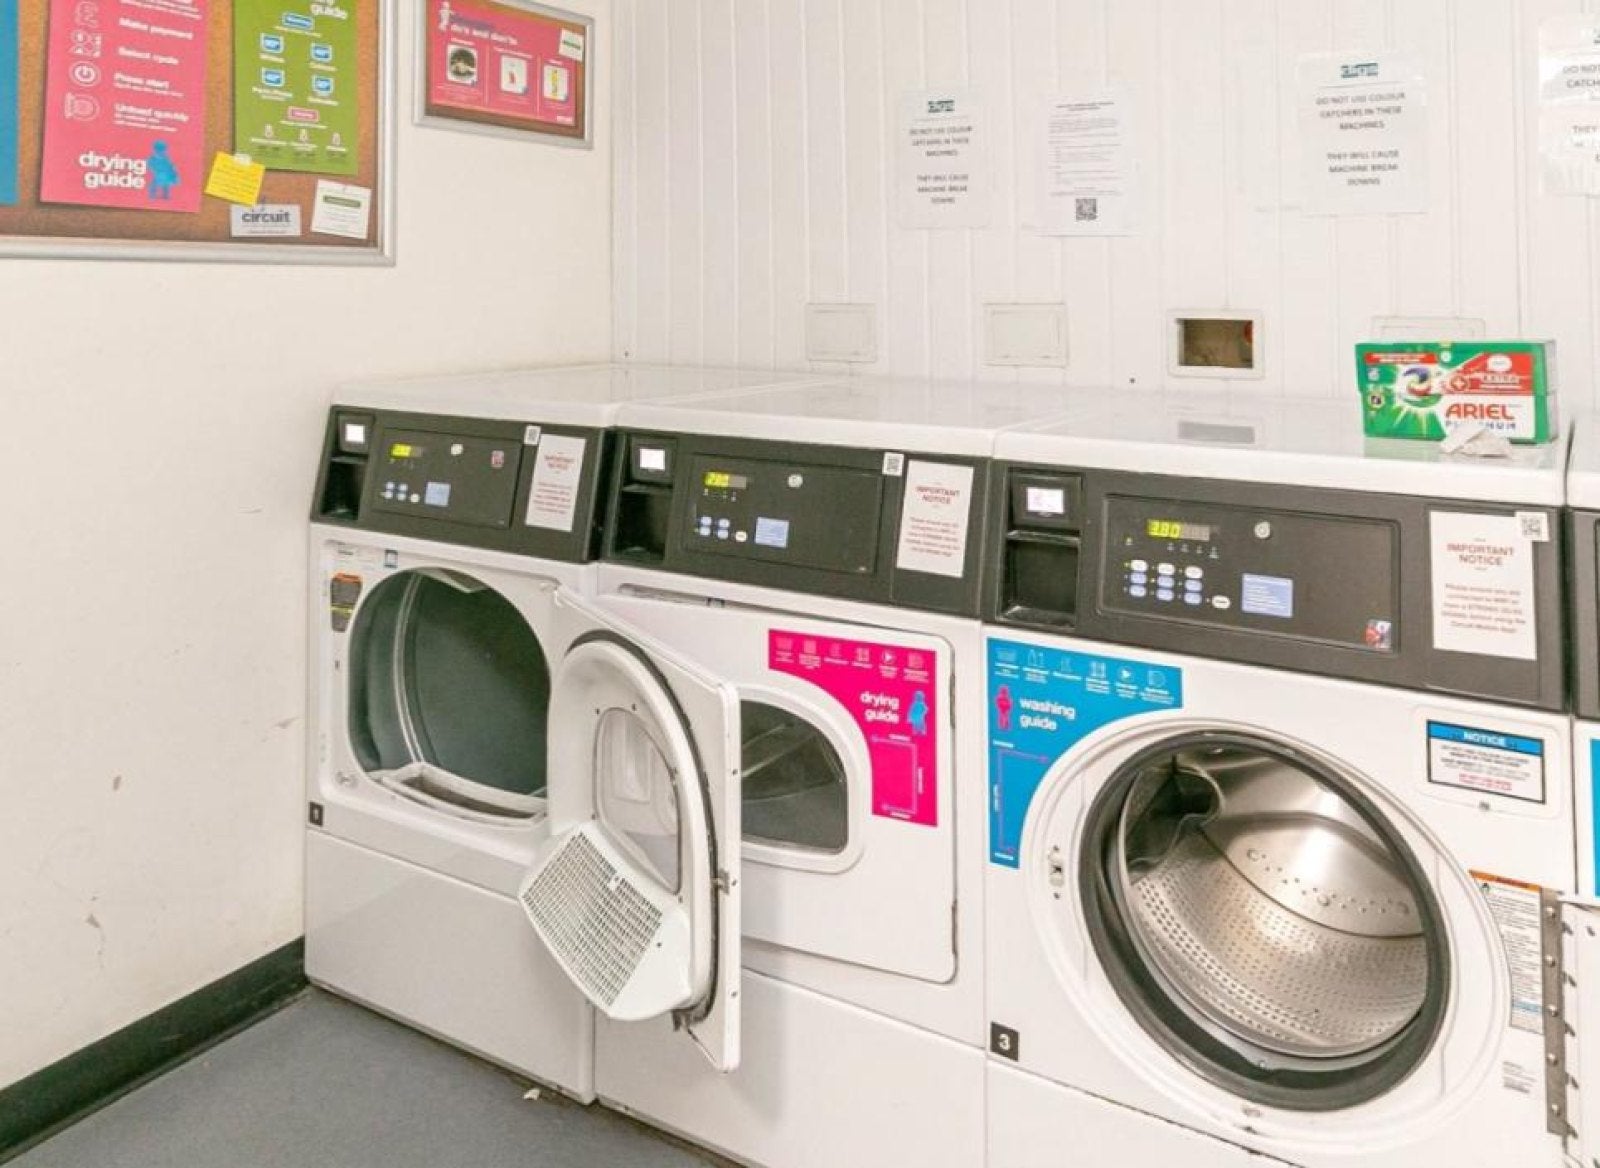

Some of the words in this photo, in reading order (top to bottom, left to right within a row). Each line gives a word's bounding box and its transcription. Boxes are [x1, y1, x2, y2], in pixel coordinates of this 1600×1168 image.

[1368, 92, 1405, 102] COLOUR
[1371, 148, 1399, 158] CAUSE
[79, 151, 147, 175] drying
[1328, 164, 1368, 173] MACHINE
[84, 172, 147, 190] guide
[242, 209, 291, 223] circuit
[1445, 403, 1515, 420] ARIEL
[1446, 543, 1515, 556] IMPORTANT
[1458, 555, 1503, 566] NOTICE
[860, 691, 900, 709] drying
[864, 708, 900, 724] guide
[1019, 697, 1076, 720] washing
[1019, 715, 1057, 731] guide
[1463, 731, 1506, 746] NOTICE
[998, 1033, 1011, 1051] 3
